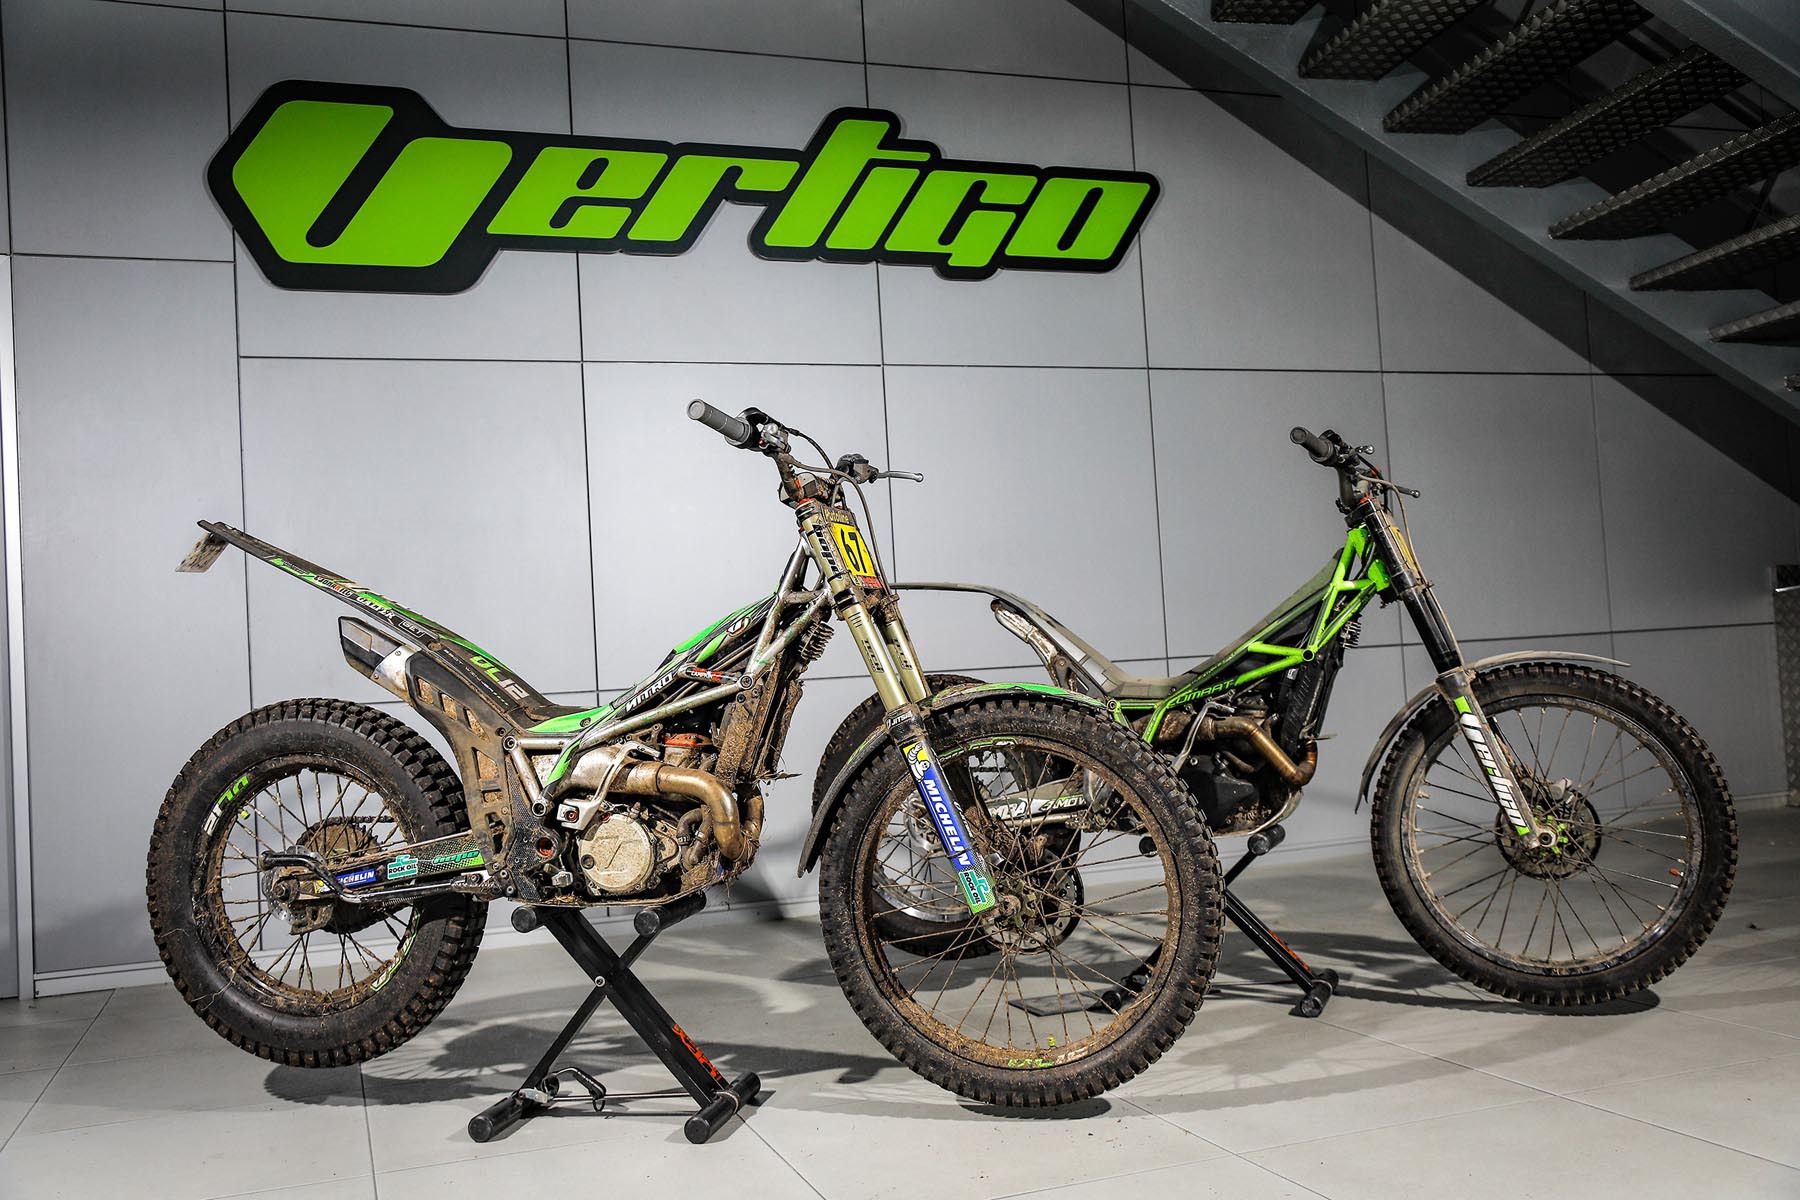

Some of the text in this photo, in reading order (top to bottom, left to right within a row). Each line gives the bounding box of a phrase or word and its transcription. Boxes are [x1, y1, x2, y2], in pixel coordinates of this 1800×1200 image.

[231, 99, 1153, 267] Vertigo
[840, 527, 868, 574] 67
[356, 596, 395, 623] GALFER
[923, 779, 972, 867] MICHELIN
[389, 866, 405, 875] ROCK
[963, 871, 977, 892] ROCK
